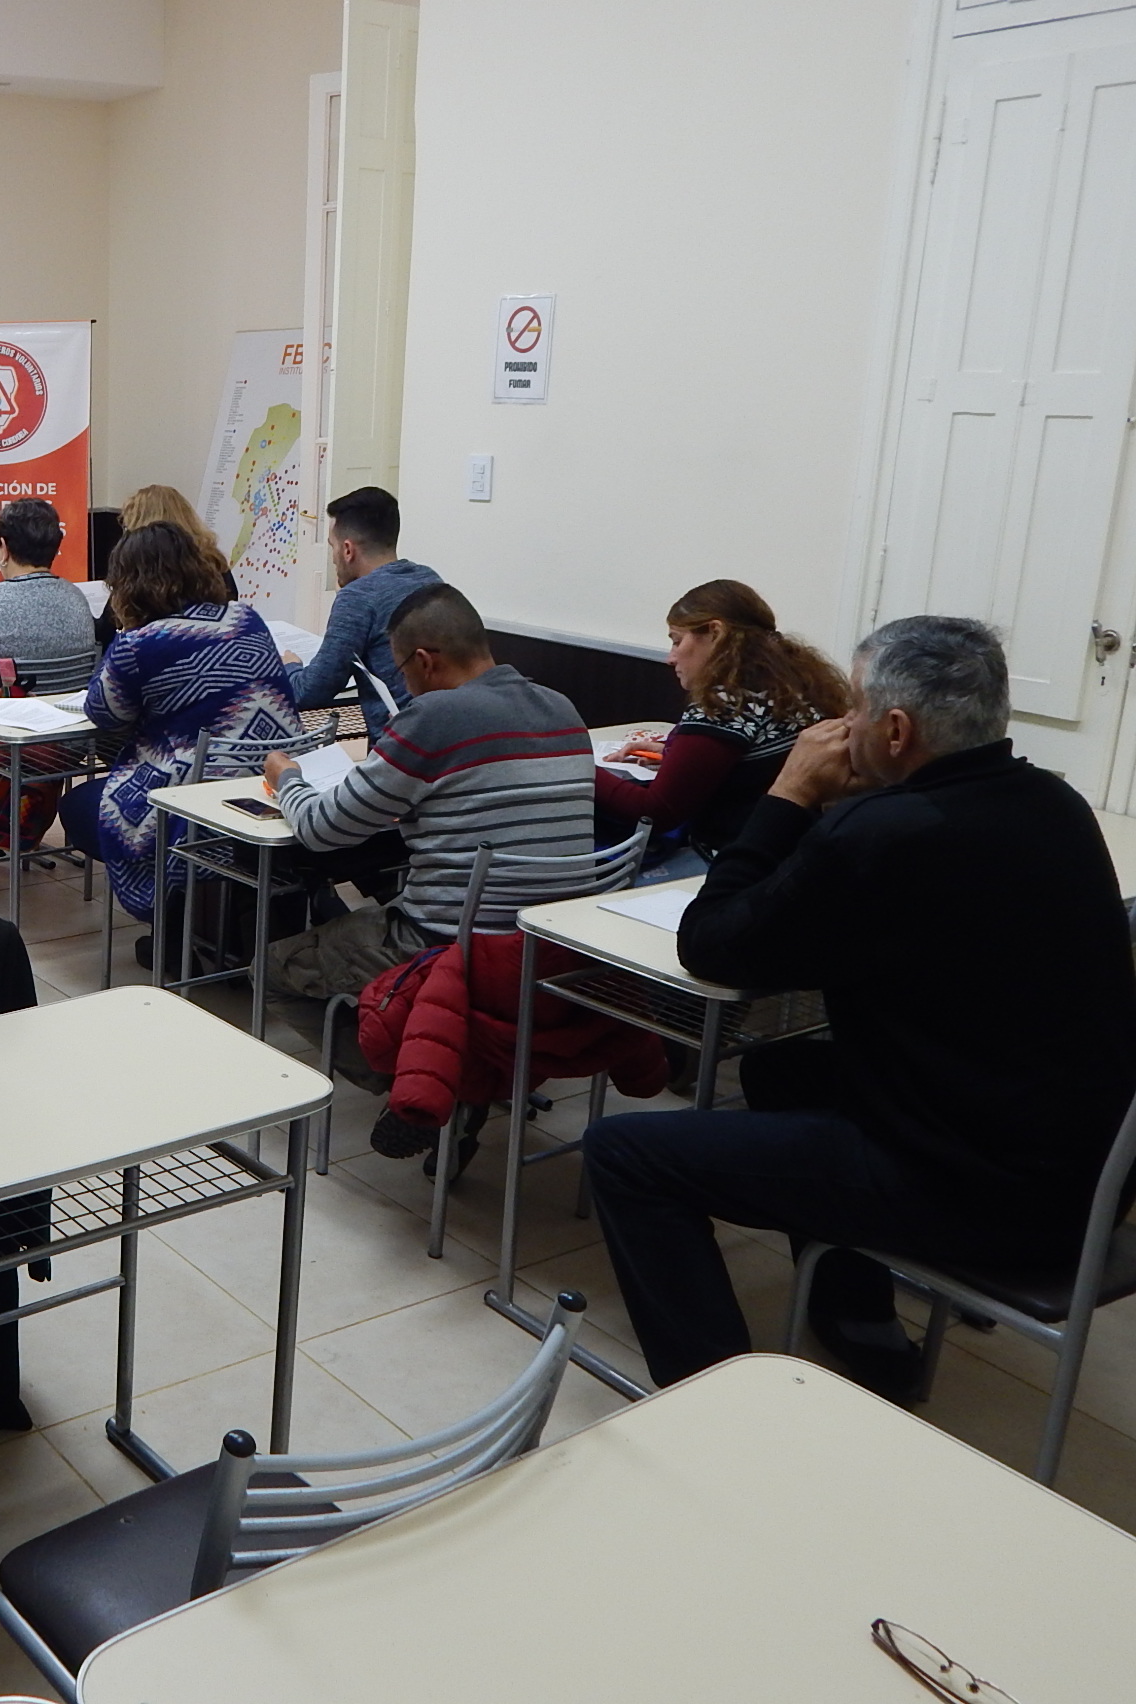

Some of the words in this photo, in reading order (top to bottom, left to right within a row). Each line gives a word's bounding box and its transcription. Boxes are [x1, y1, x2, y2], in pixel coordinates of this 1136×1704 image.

[504, 361, 537, 372] PROHIBIDO
[15, 352, 44, 395] VOLUNTARIOS
[509, 379, 531, 388] FUMAR
[37, 483, 57, 495] DE
